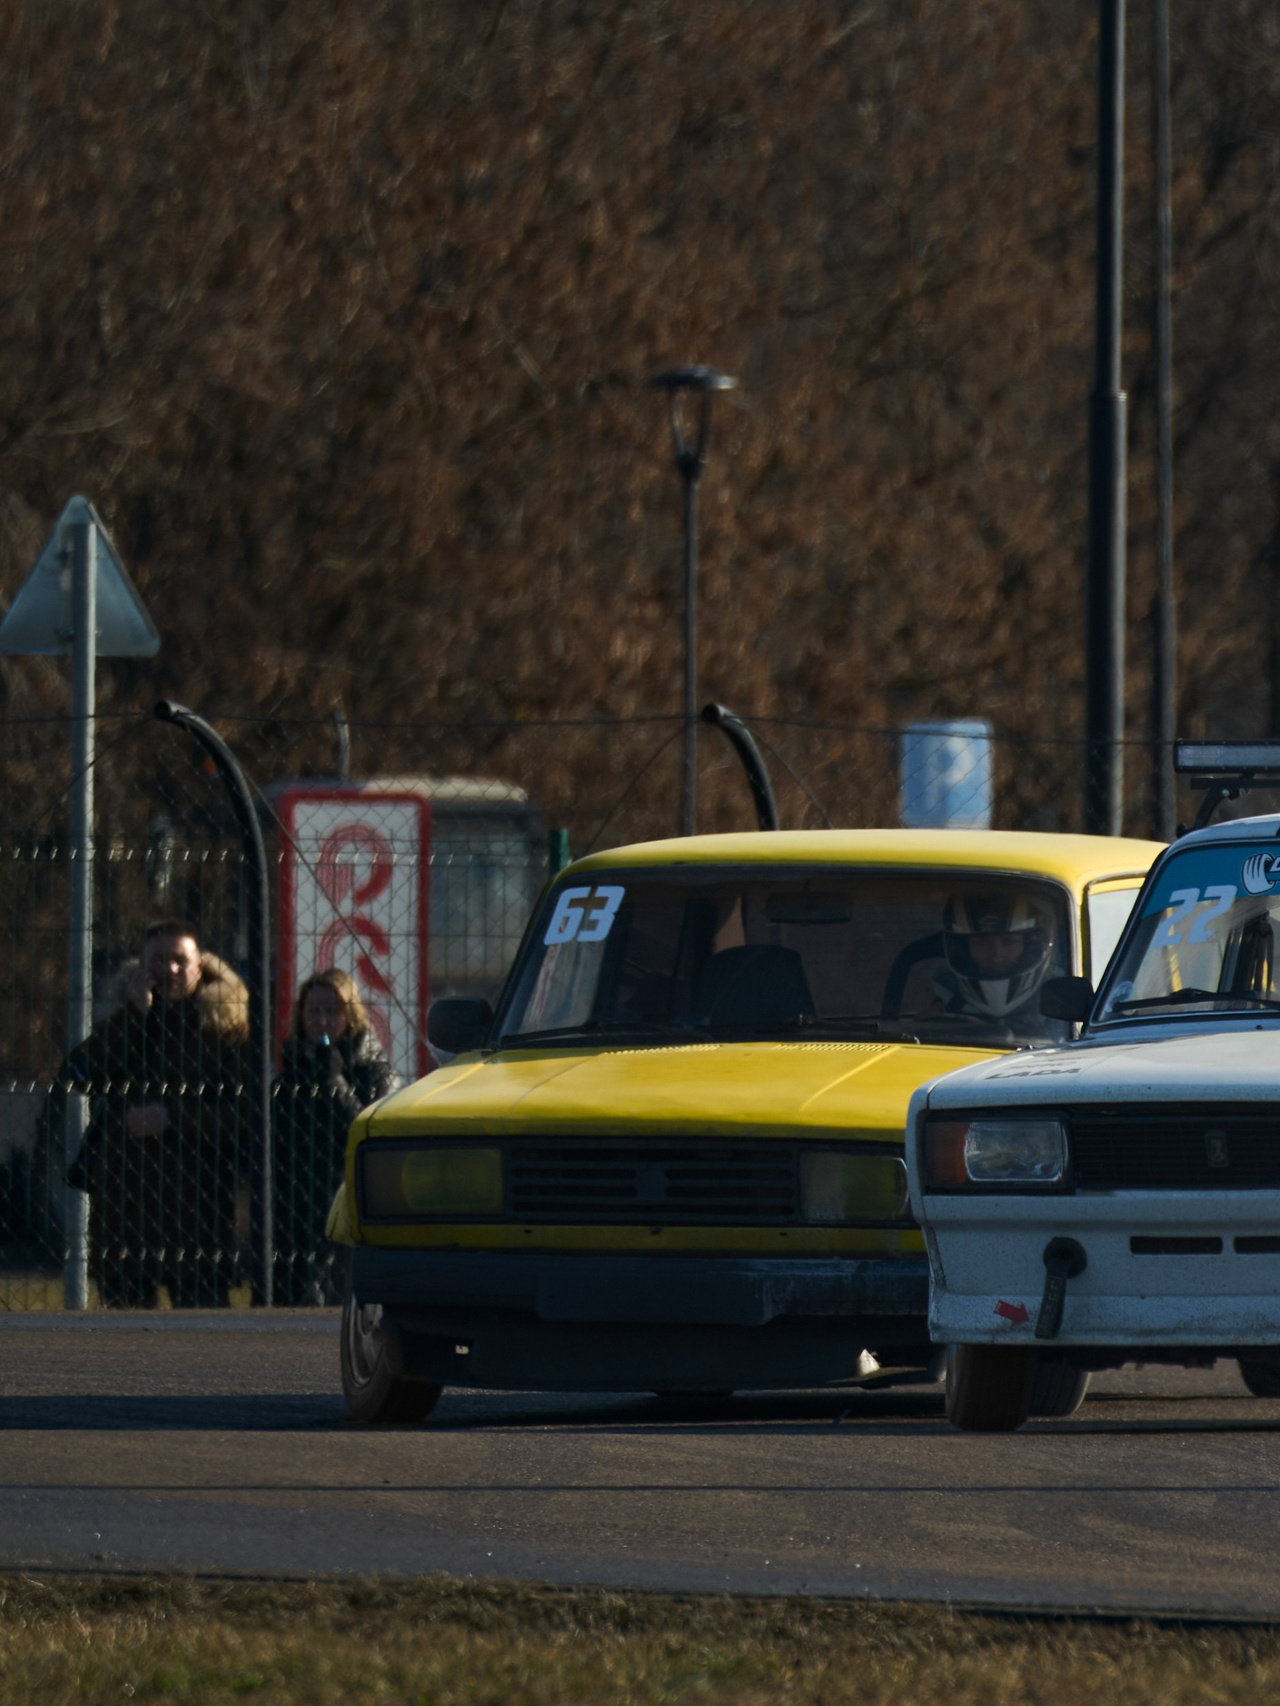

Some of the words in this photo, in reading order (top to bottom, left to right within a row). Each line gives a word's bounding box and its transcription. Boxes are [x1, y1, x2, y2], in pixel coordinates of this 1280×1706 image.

[543, 885, 626, 946] 63
[1151, 884, 1238, 949] 22
[984, 1067, 1081, 1080] LADA
